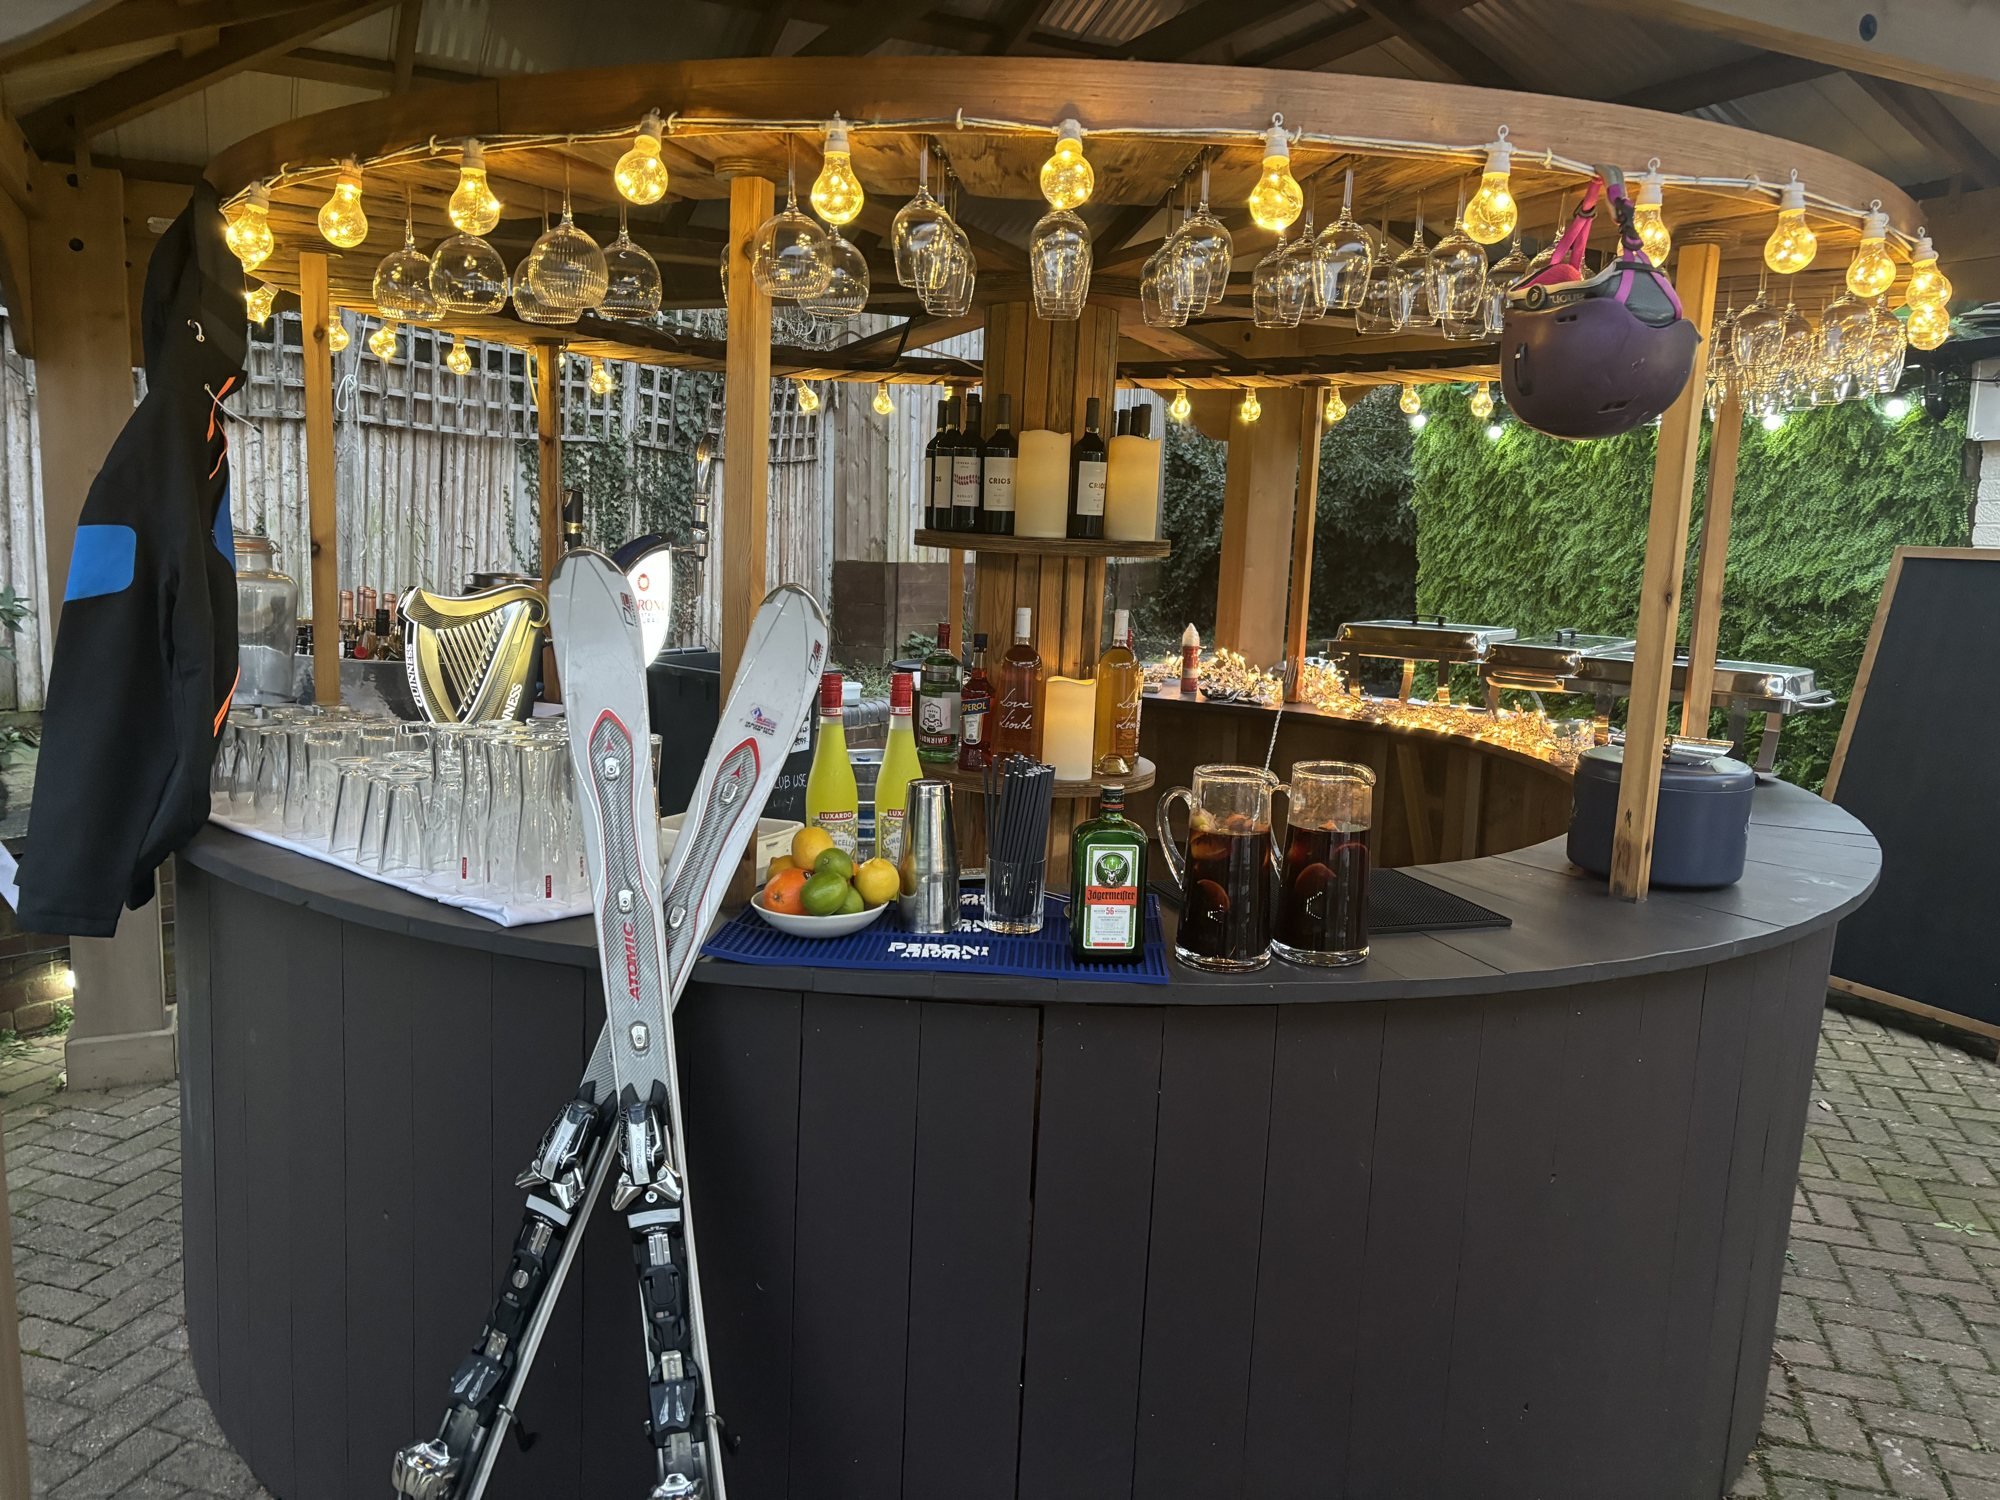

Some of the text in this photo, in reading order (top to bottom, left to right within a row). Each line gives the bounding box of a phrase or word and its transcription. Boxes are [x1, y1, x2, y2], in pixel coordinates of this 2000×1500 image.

[988, 477, 1011, 485] CRIOS
[406, 644, 424, 708] GUINNESS
[1000, 688, 1032, 708] Love
[793, 773, 806, 788] USE
[821, 812, 852, 820] LUXARDO
[1087, 889, 1136, 902] Jägermeister
[1105, 907, 1115, 915] 56
[888, 942, 989, 958] PERONI
[623, 922, 640, 1001] ATOMIC
